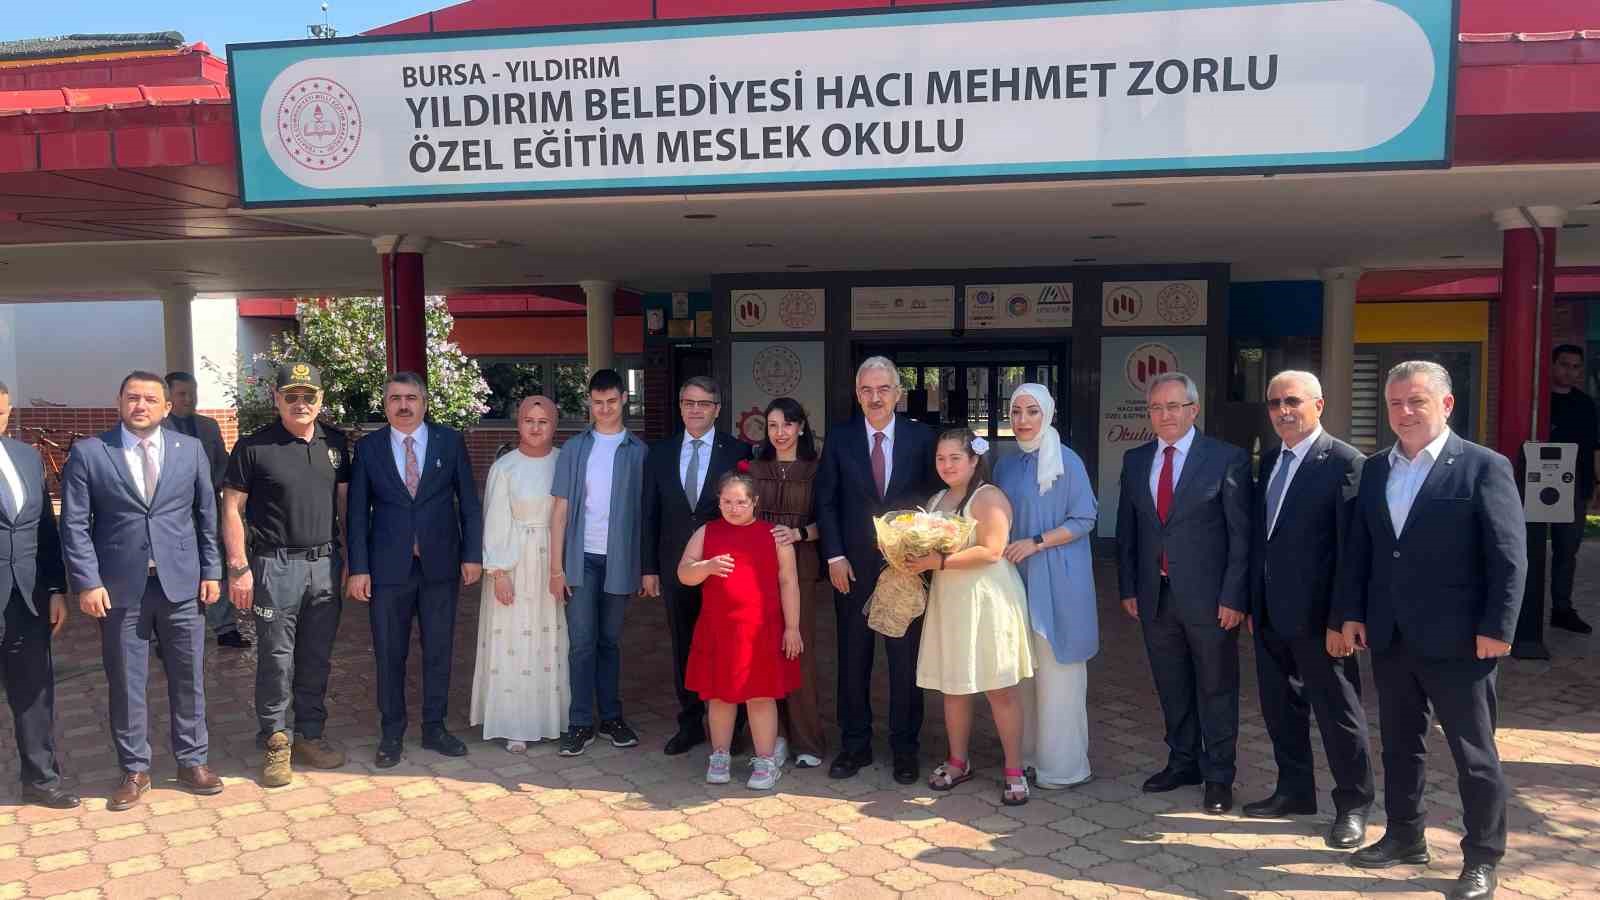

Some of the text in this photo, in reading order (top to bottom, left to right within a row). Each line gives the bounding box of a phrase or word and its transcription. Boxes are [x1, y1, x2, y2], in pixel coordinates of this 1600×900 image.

[402, 63, 487, 88] BURSA
[504, 56, 620, 83] YILDIRIM
[405, 54, 1278, 129] YILDIRIM BELEDİYESİ HACI MEHMET ZORLU
[409, 119, 964, 174] ÖZEL EĞİTİM MESLEK OKULU
